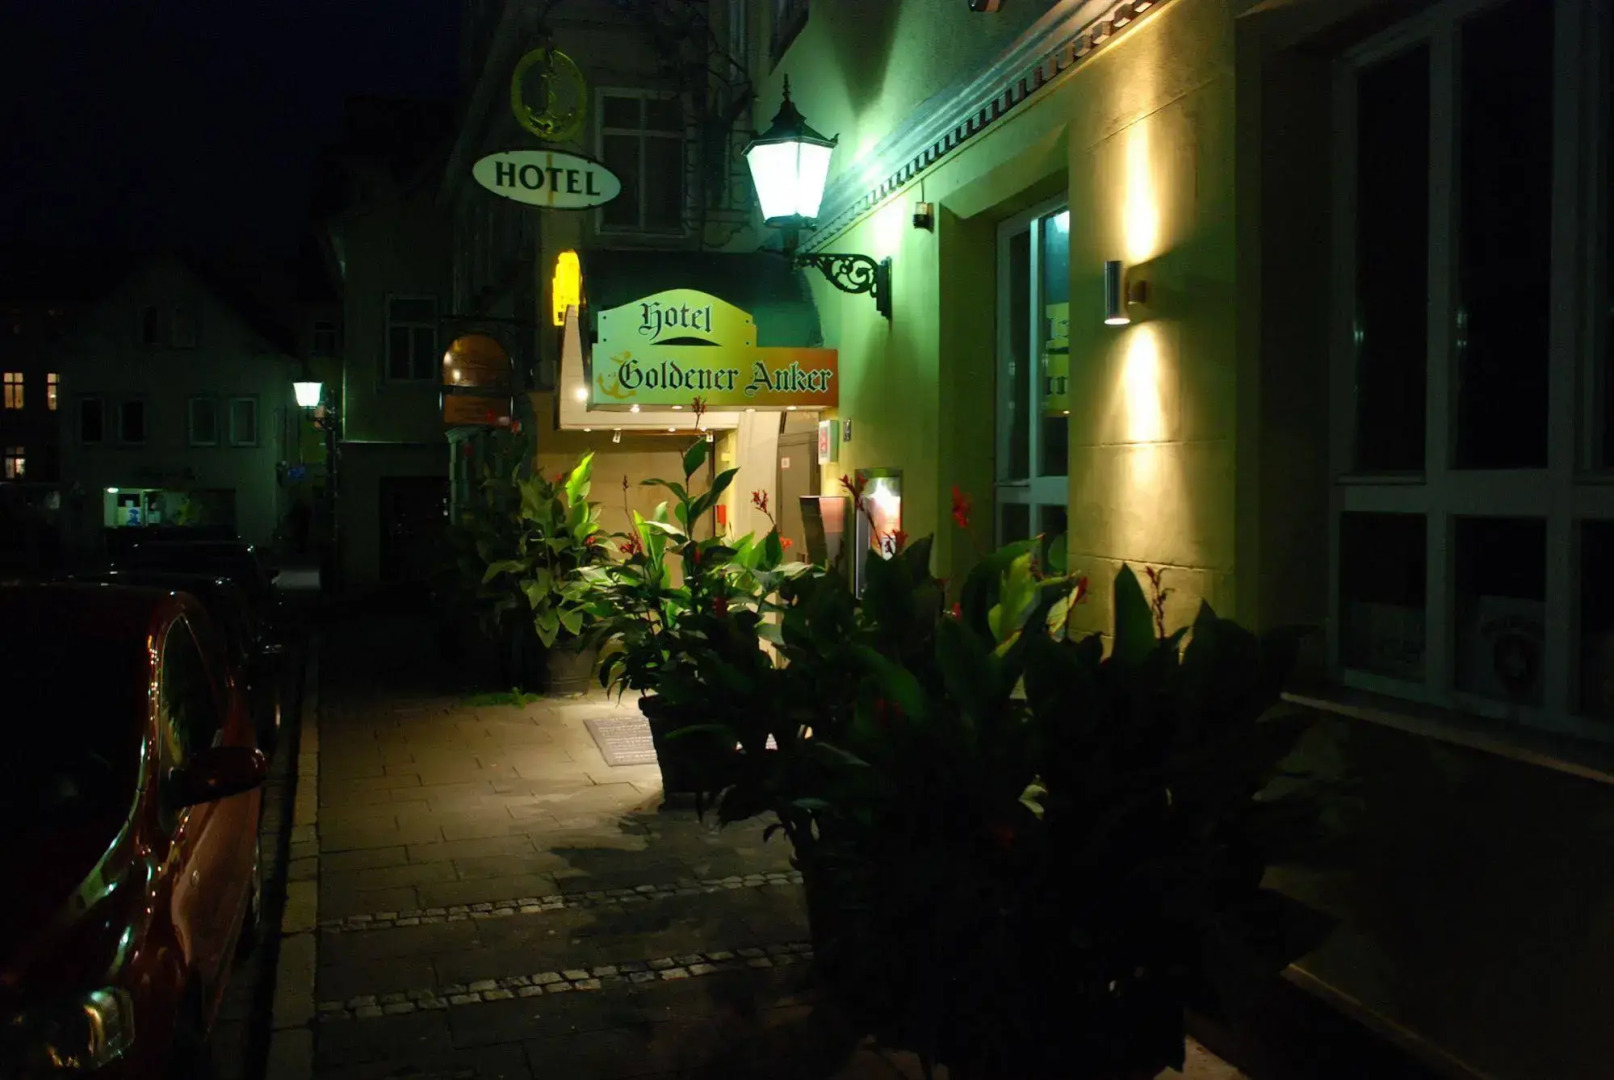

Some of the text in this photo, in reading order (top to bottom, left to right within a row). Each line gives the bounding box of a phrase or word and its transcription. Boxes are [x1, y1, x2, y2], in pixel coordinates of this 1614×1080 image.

[494, 161, 601, 197] HOTEL
[639, 302, 712, 340] Hotel
[618, 358, 834, 395] Goldener Anker
